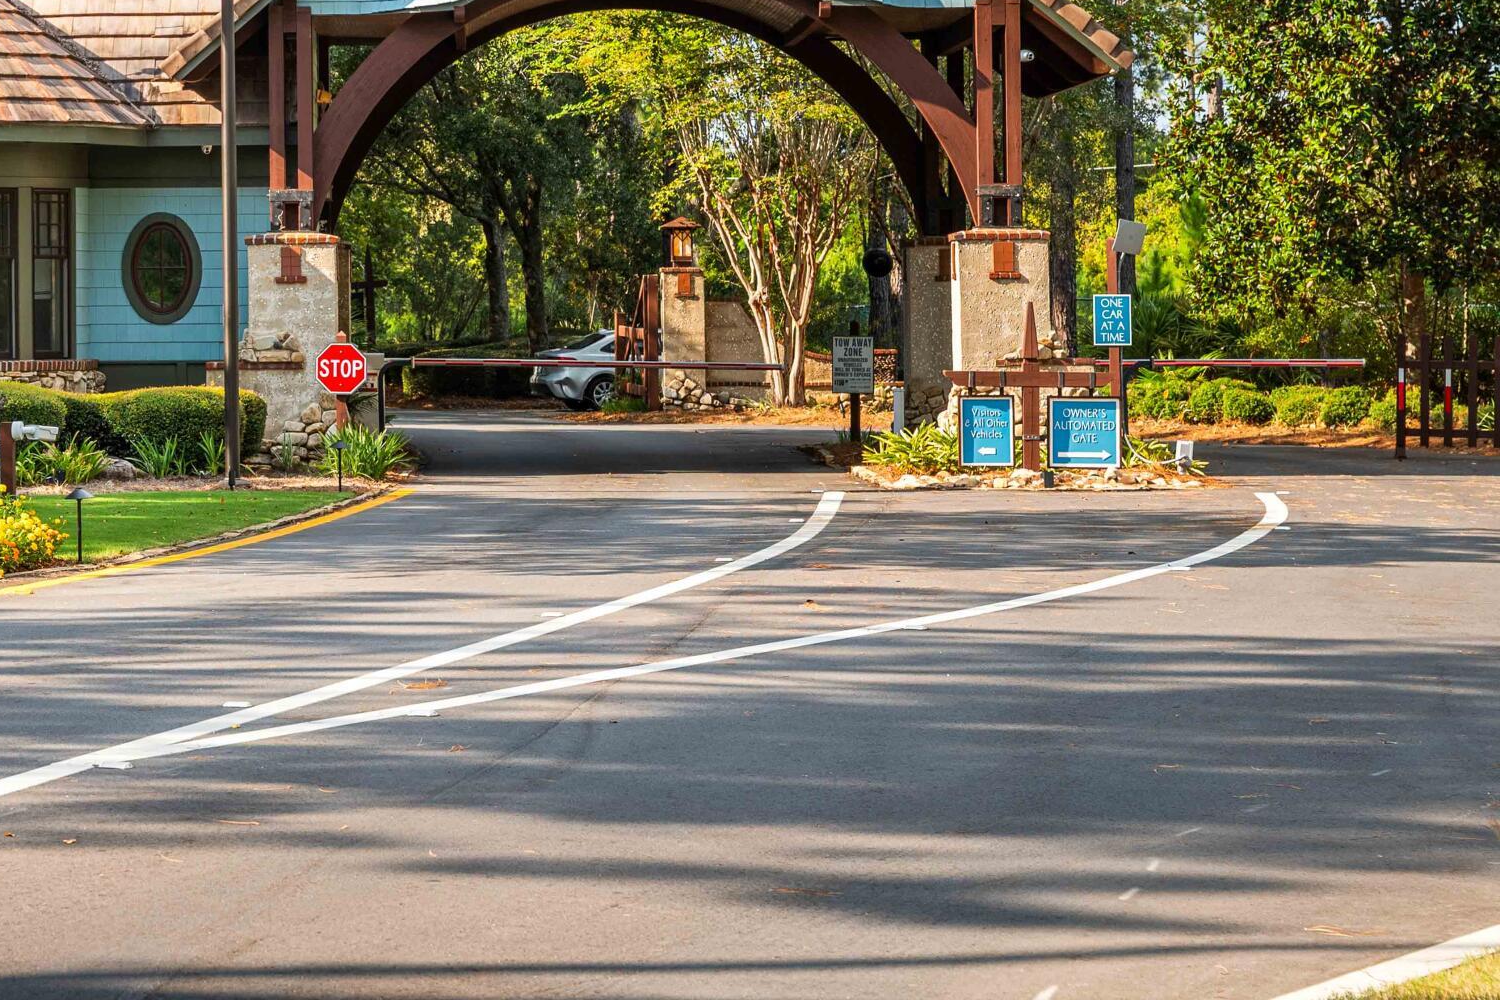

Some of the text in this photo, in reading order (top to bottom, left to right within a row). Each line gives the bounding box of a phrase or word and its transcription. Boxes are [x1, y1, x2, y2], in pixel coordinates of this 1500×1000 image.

[1100, 298, 1123, 307] ONE
[1101, 310, 1123, 319] CAR
[1101, 321, 1125, 330] AT A
[1100, 332, 1125, 342] TIME
[835, 338, 872, 347] TOW AWAY
[844, 348, 862, 356] ZONE
[319, 359, 364, 378] STOP
[971, 408, 1002, 417] Visitors
[1062, 408, 1107, 418] OWNER'S
[972, 418, 984, 427] All
[986, 418, 1009, 428] Other
[1053, 420, 1116, 431] AUTOMATED
[970, 429, 1003, 439] Vehicles
[1071, 432, 1098, 443] GATE
